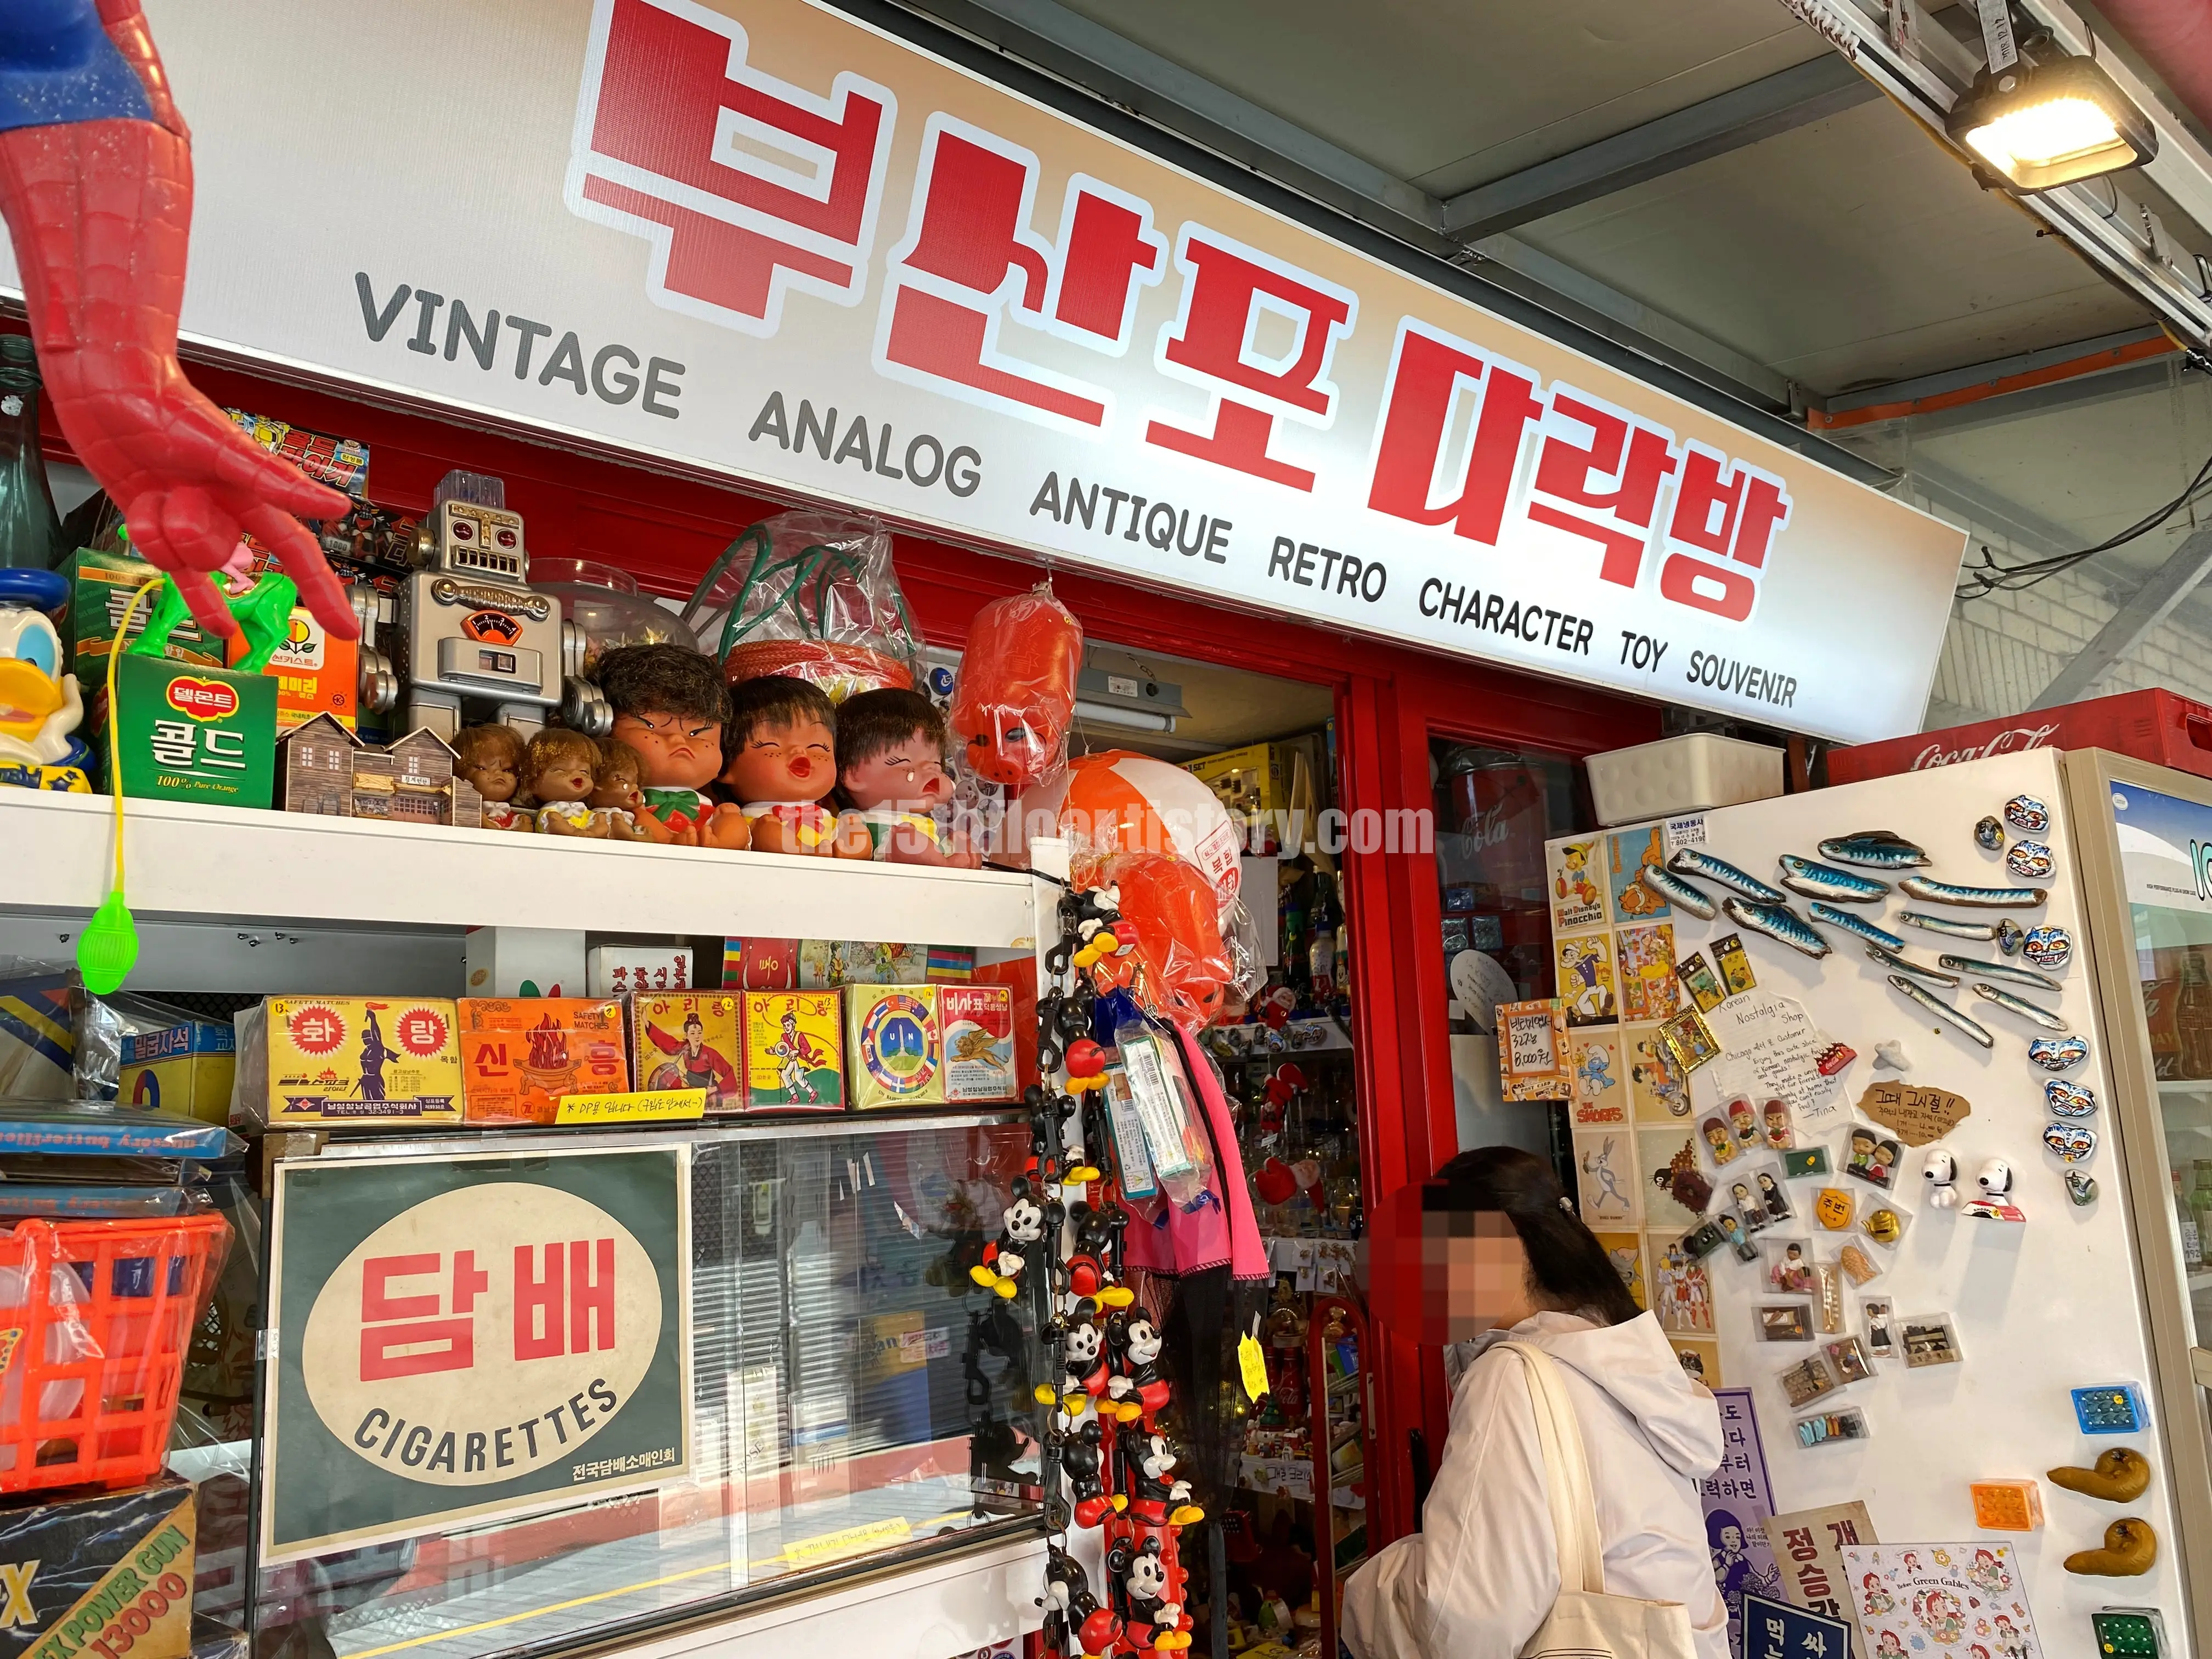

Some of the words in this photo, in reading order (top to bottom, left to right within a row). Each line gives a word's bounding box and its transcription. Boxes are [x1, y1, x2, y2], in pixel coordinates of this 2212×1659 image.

[583, 0, 1350, 492] 부산포
[1367, 330, 1787, 622] 다락방
[356, 272, 686, 419] VINTAGE
[748, 391, 981, 498] ANALOG
[1029, 471, 1233, 565] ANTIQUE
[1268, 536, 1386, 602] RETRO
[1419, 578, 1593, 656] CHARACTER
[1621, 630, 1668, 673] TOY
[1686, 650, 1797, 708] SOUVENIR
[173, 687, 232, 708] 델몬트
[150, 719, 246, 769] 콜드
[156, 775, 191, 789] 100%
[212, 782, 239, 793] Orange
[1670, 818, 1703, 830] 국제냉동사
[1557, 908, 1573, 916] Walt
[1573, 902, 1601, 913] Disney's
[1559, 911, 1602, 927] Pinocchio
[653, 997, 725, 1018] 아리랑
[753, 998, 828, 1017] 아리랑
[946, 992, 983, 1012] 비사표
[1718, 994, 1751, 1013] Korean
[573, 1011, 602, 1020] SAFETY
[1736, 1001, 1786, 1025] Nostalgia
[1781, 1012, 1804, 1024] Shop
[302, 1018, 336, 1042] 화
[410, 1019, 438, 1045] 랑
[574, 1021, 610, 1030] MATCHES
[1725, 1048, 1752, 1061] Chicago
[1778, 1028, 1805, 1042] Customer
[1786, 1045, 1800, 1053] cute
[473, 1043, 509, 1076] 신
[588, 1040, 620, 1076] 흥
[1514, 1048, 1554, 1066] 8,000원
[1760, 1062, 1780, 1074] Korean
[1784, 1053, 1810, 1064] nostalgic
[1875, 1089, 1901, 1107] 그때
[1576, 1107, 1623, 1123] SMURFS
[359, 1238, 616, 1381] 담배
[354, 1377, 617, 1474] CIGARETTES
[572, 1447, 676, 1482] 전국담배소매인회
[1700, 1479, 1757, 1500] 력하면
[63, 1567, 148, 1647] POWER
[135, 1524, 190, 1575] GUN
[1897, 1581, 1912, 1590] Before
[1912, 1577, 1939, 1586] Green
[1940, 1577, 1970, 1591] Gables
[89, 1572, 188, 1659] 13000
